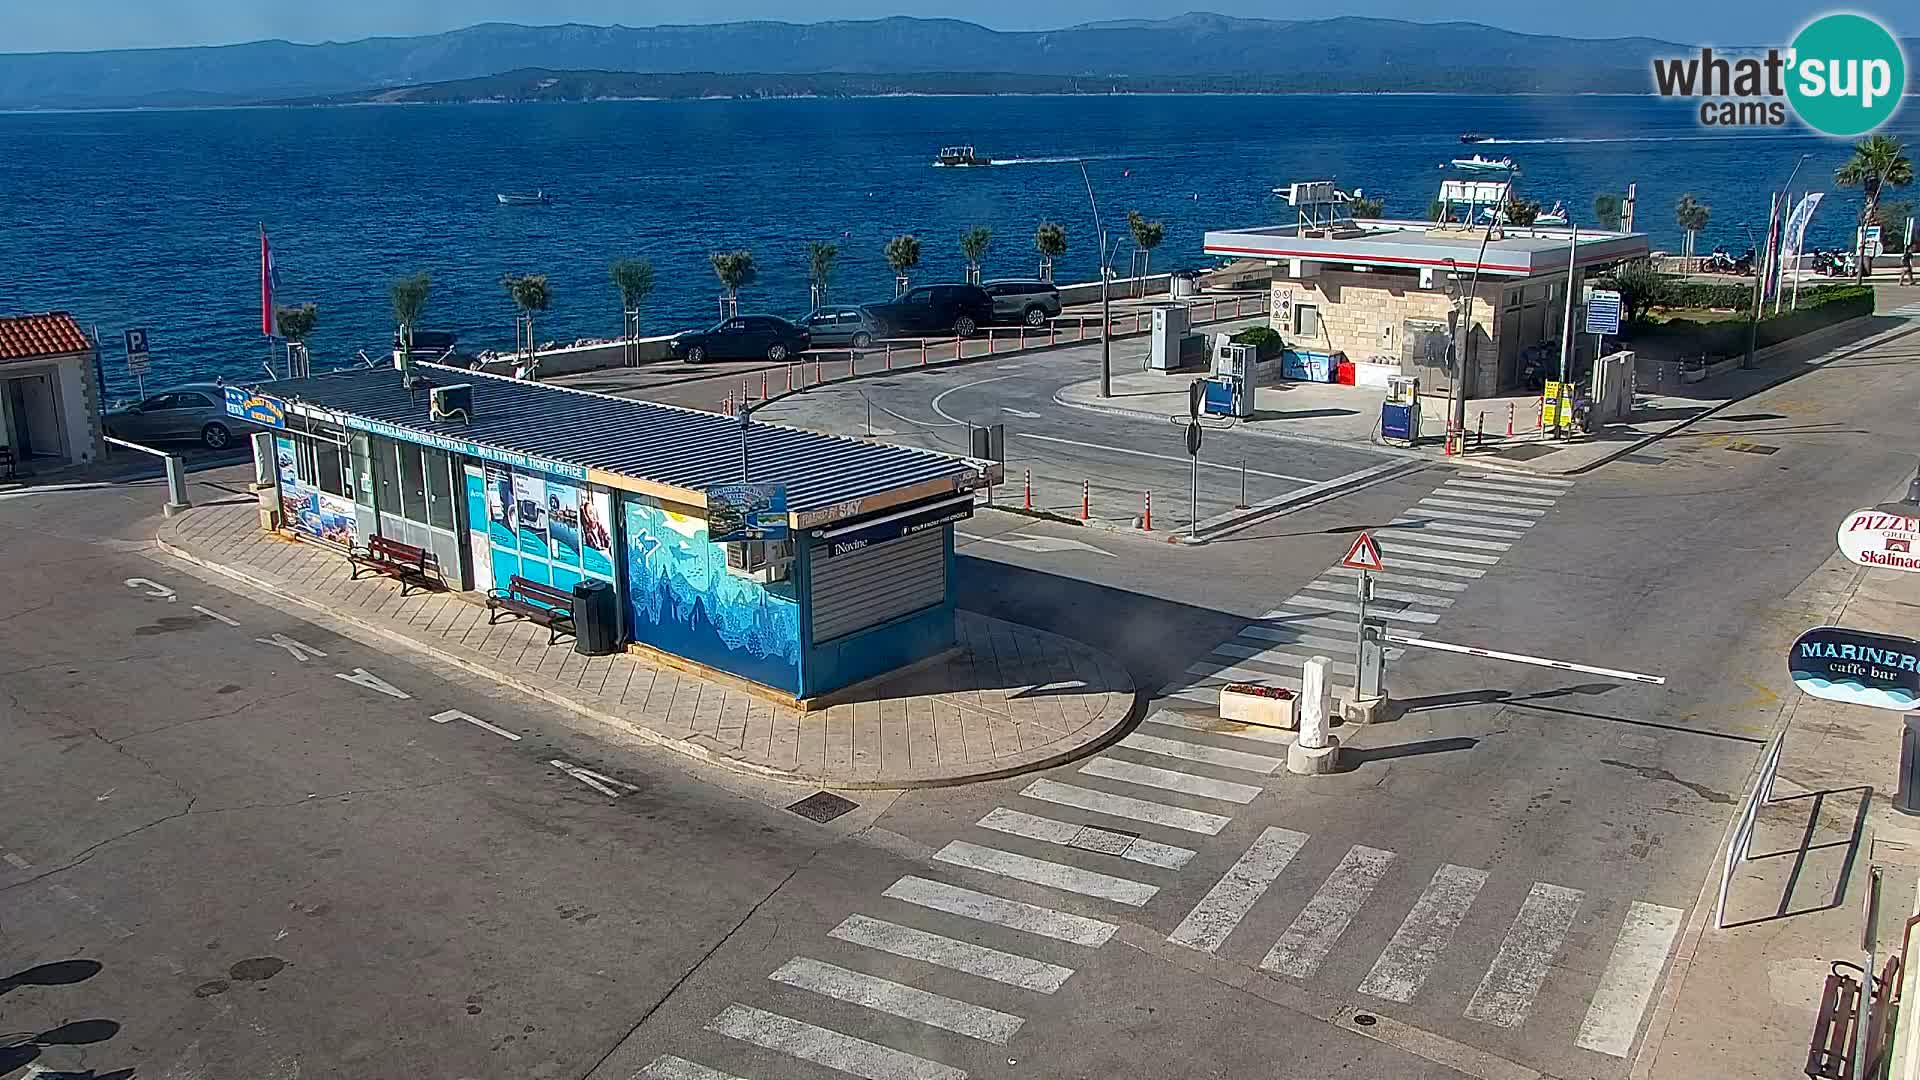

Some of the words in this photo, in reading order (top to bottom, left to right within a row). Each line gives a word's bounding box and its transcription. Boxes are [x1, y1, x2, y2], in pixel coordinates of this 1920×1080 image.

[130, 331, 143, 351] P
[436, 436, 468, 453] POSTAJA
[477, 446, 493, 459] BUS
[493, 449, 526, 466] STATION
[528, 457, 554, 473] TICKET
[555, 462, 584, 479] OFFICE
[1882, 530, 1918, 540] GRILL
[1800, 642, 1920, 672] MARINER
[1829, 661, 1866, 677] caffe
[1870, 668, 1897, 681] bar
